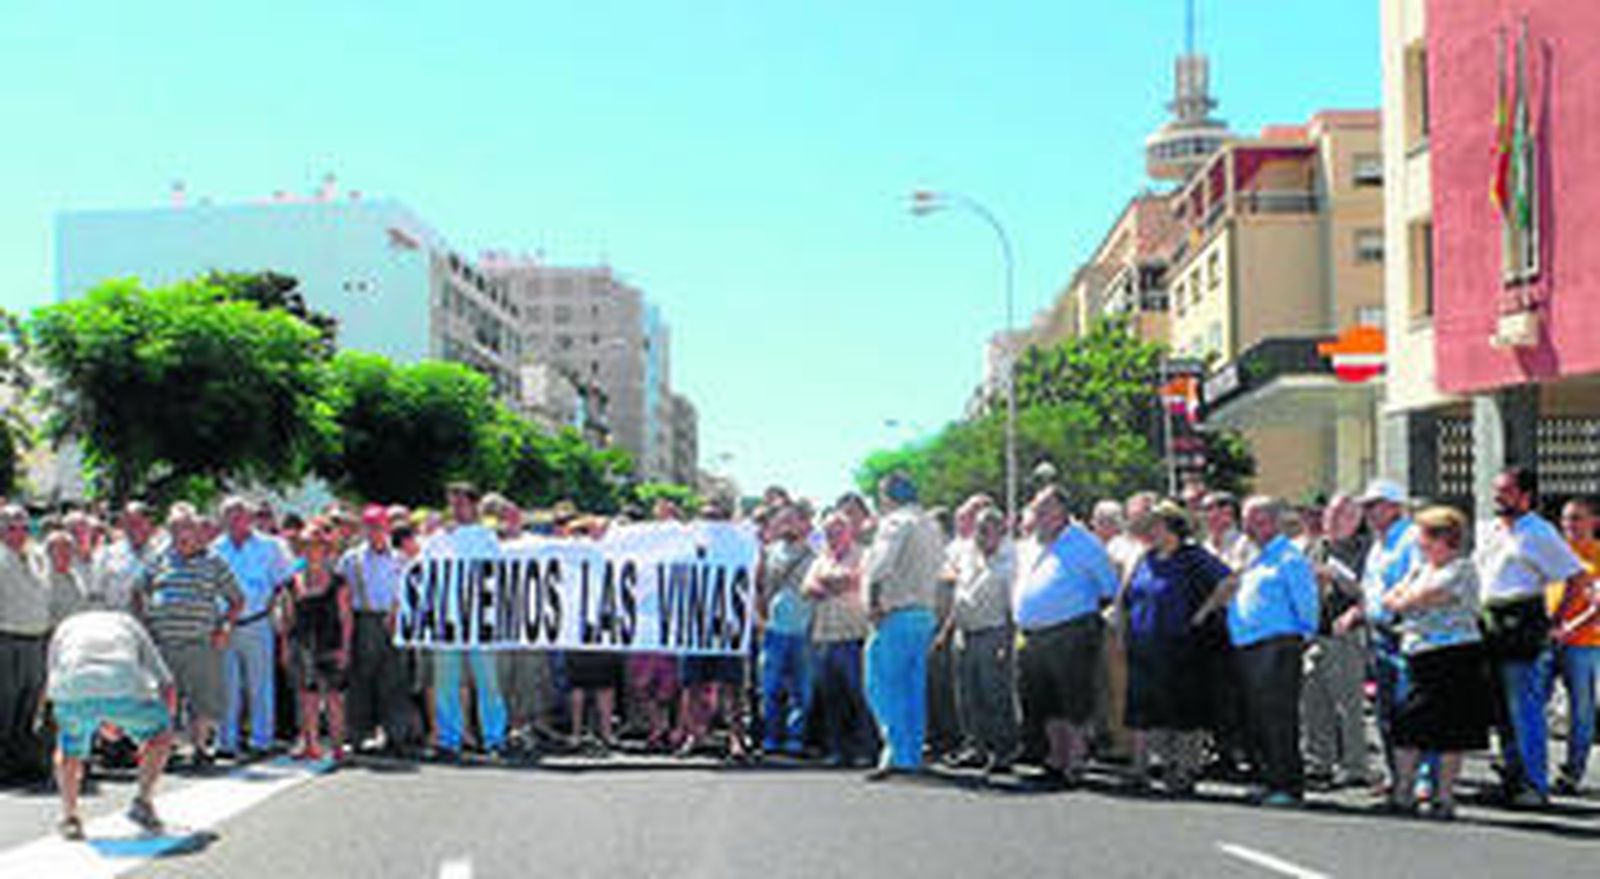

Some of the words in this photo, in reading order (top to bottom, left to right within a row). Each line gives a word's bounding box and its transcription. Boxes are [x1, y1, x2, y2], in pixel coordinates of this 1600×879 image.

[400, 557, 562, 643] SALVEMOS
[580, 558, 637, 646] LAS
[657, 546, 748, 650] VIÑAS
